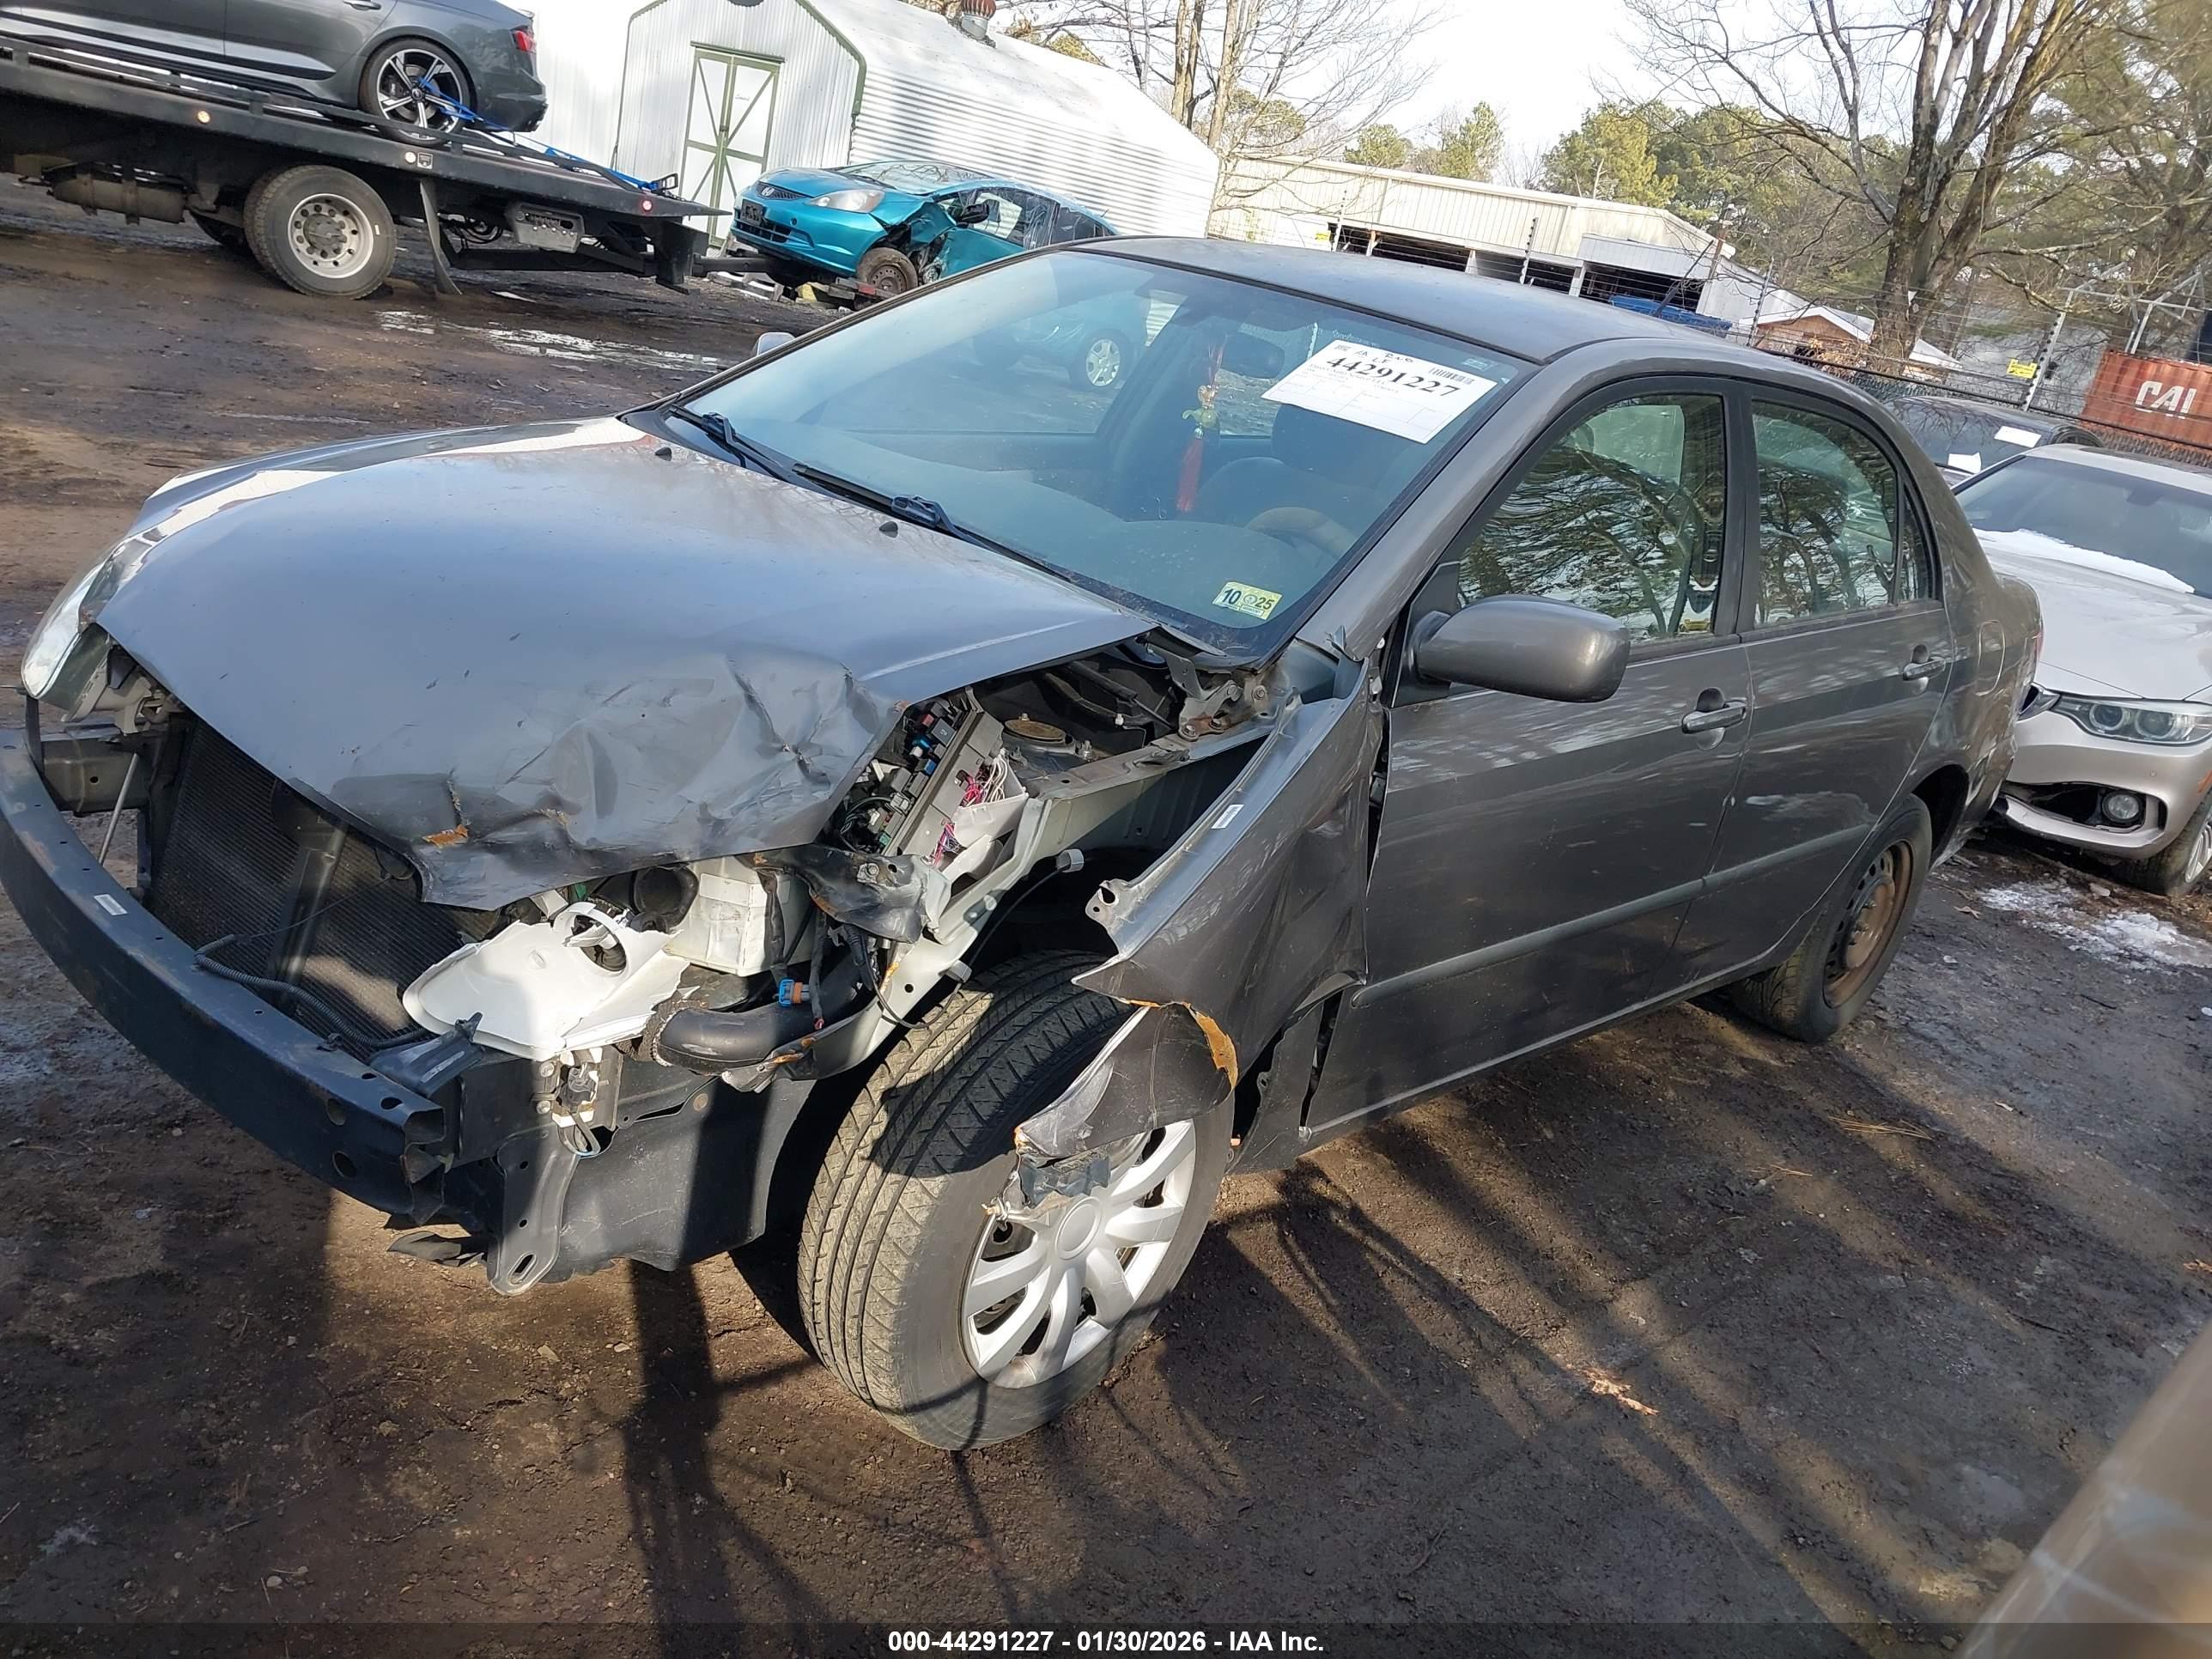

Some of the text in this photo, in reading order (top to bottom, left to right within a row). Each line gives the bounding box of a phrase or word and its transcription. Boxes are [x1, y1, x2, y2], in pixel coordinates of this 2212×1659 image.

[1327, 356, 1460, 398] 44291227
[2135, 380, 2197, 419] CAI
[1222, 588, 1242, 605] 10
[1254, 597, 1274, 611] 25
